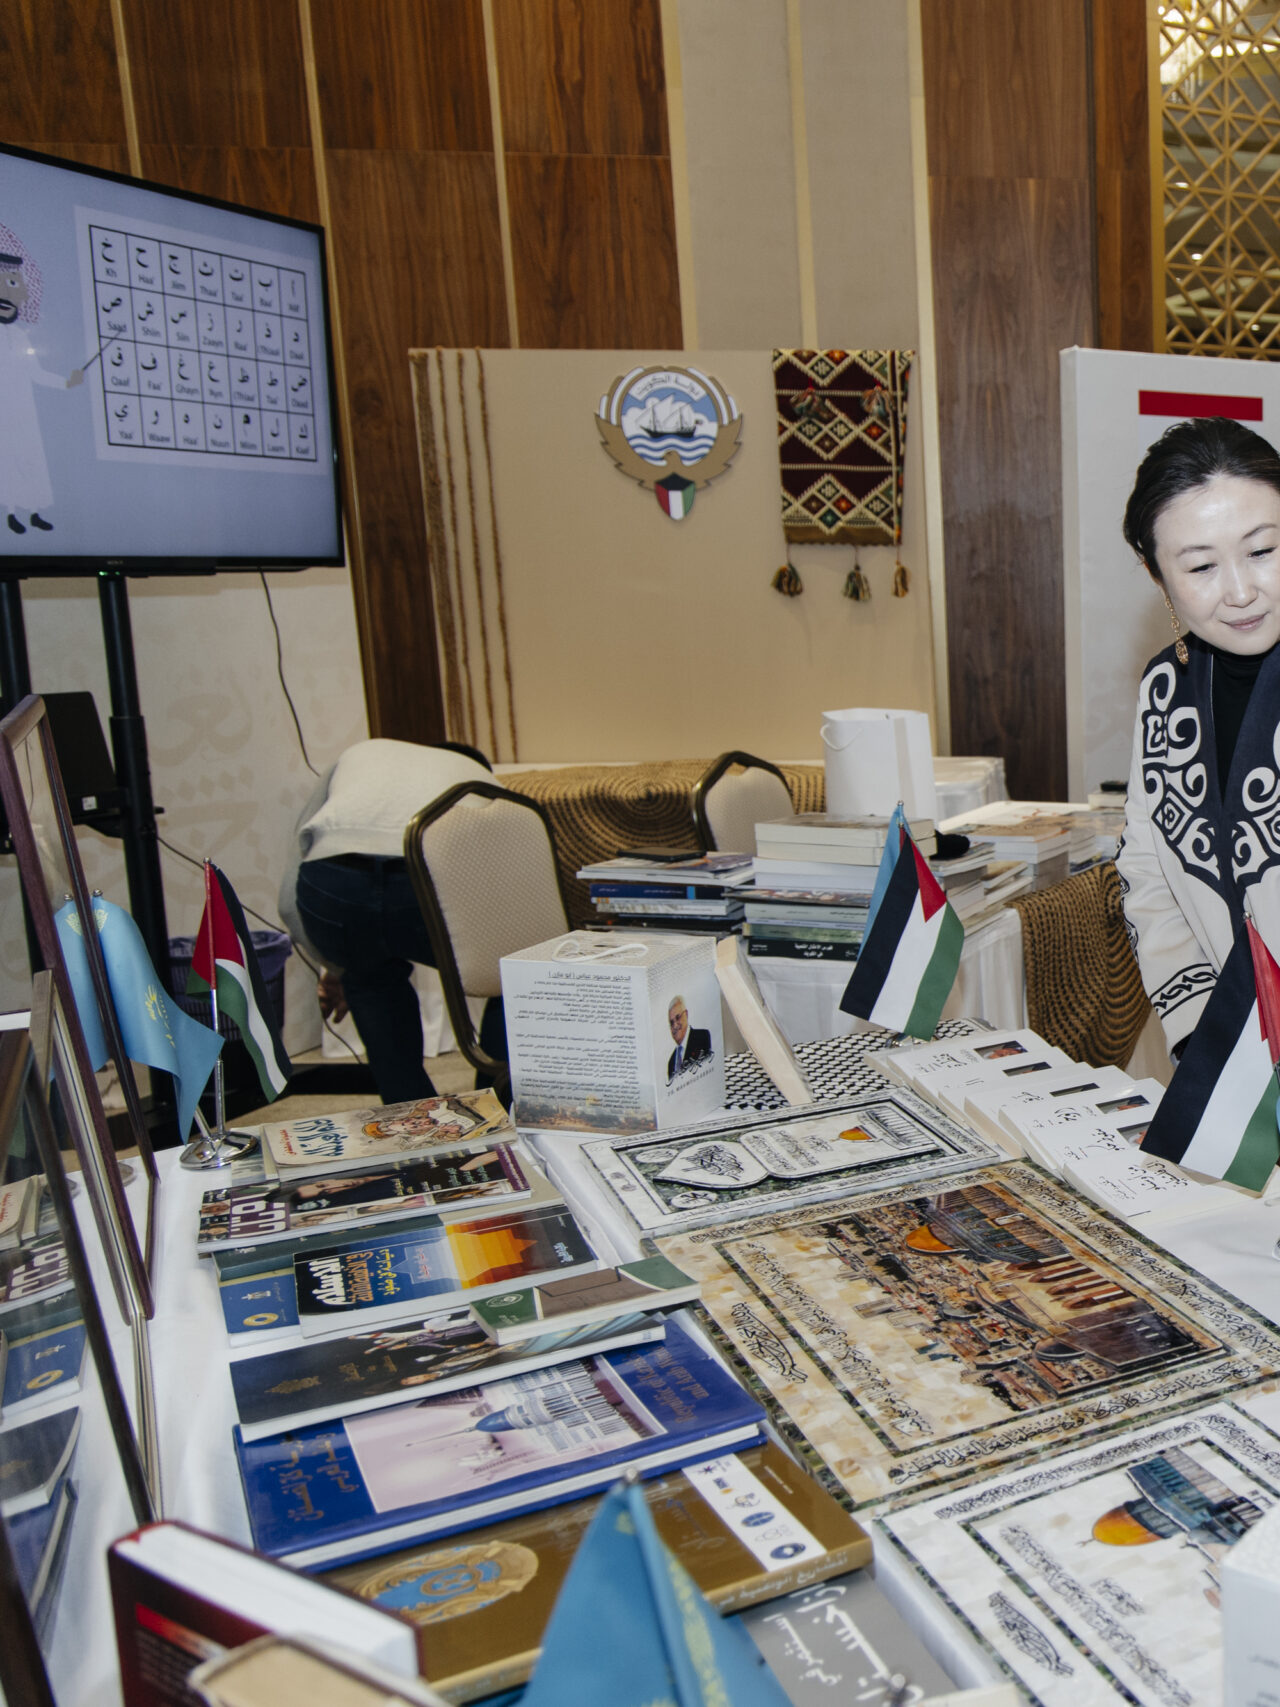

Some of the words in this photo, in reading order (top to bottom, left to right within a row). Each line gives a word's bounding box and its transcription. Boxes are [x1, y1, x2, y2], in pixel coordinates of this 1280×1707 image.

[102, 238, 115, 263] خ
[136, 247, 149, 269] ح
[168, 254, 180, 275] ج
[258, 279, 272, 292] ب
[102, 298, 122, 313] ص
[138, 302, 154, 321] ش
[171, 311, 187, 324] س
[111, 347, 123, 367] ق
[141, 353, 157, 371] ف
[178, 354, 189, 381] غ
[208, 361, 219, 383] ع
[291, 375, 308, 392] ض
[115, 405, 128, 422] ي
[153, 410, 159, 425] و
[307, 1255, 353, 1310] الإسلام
